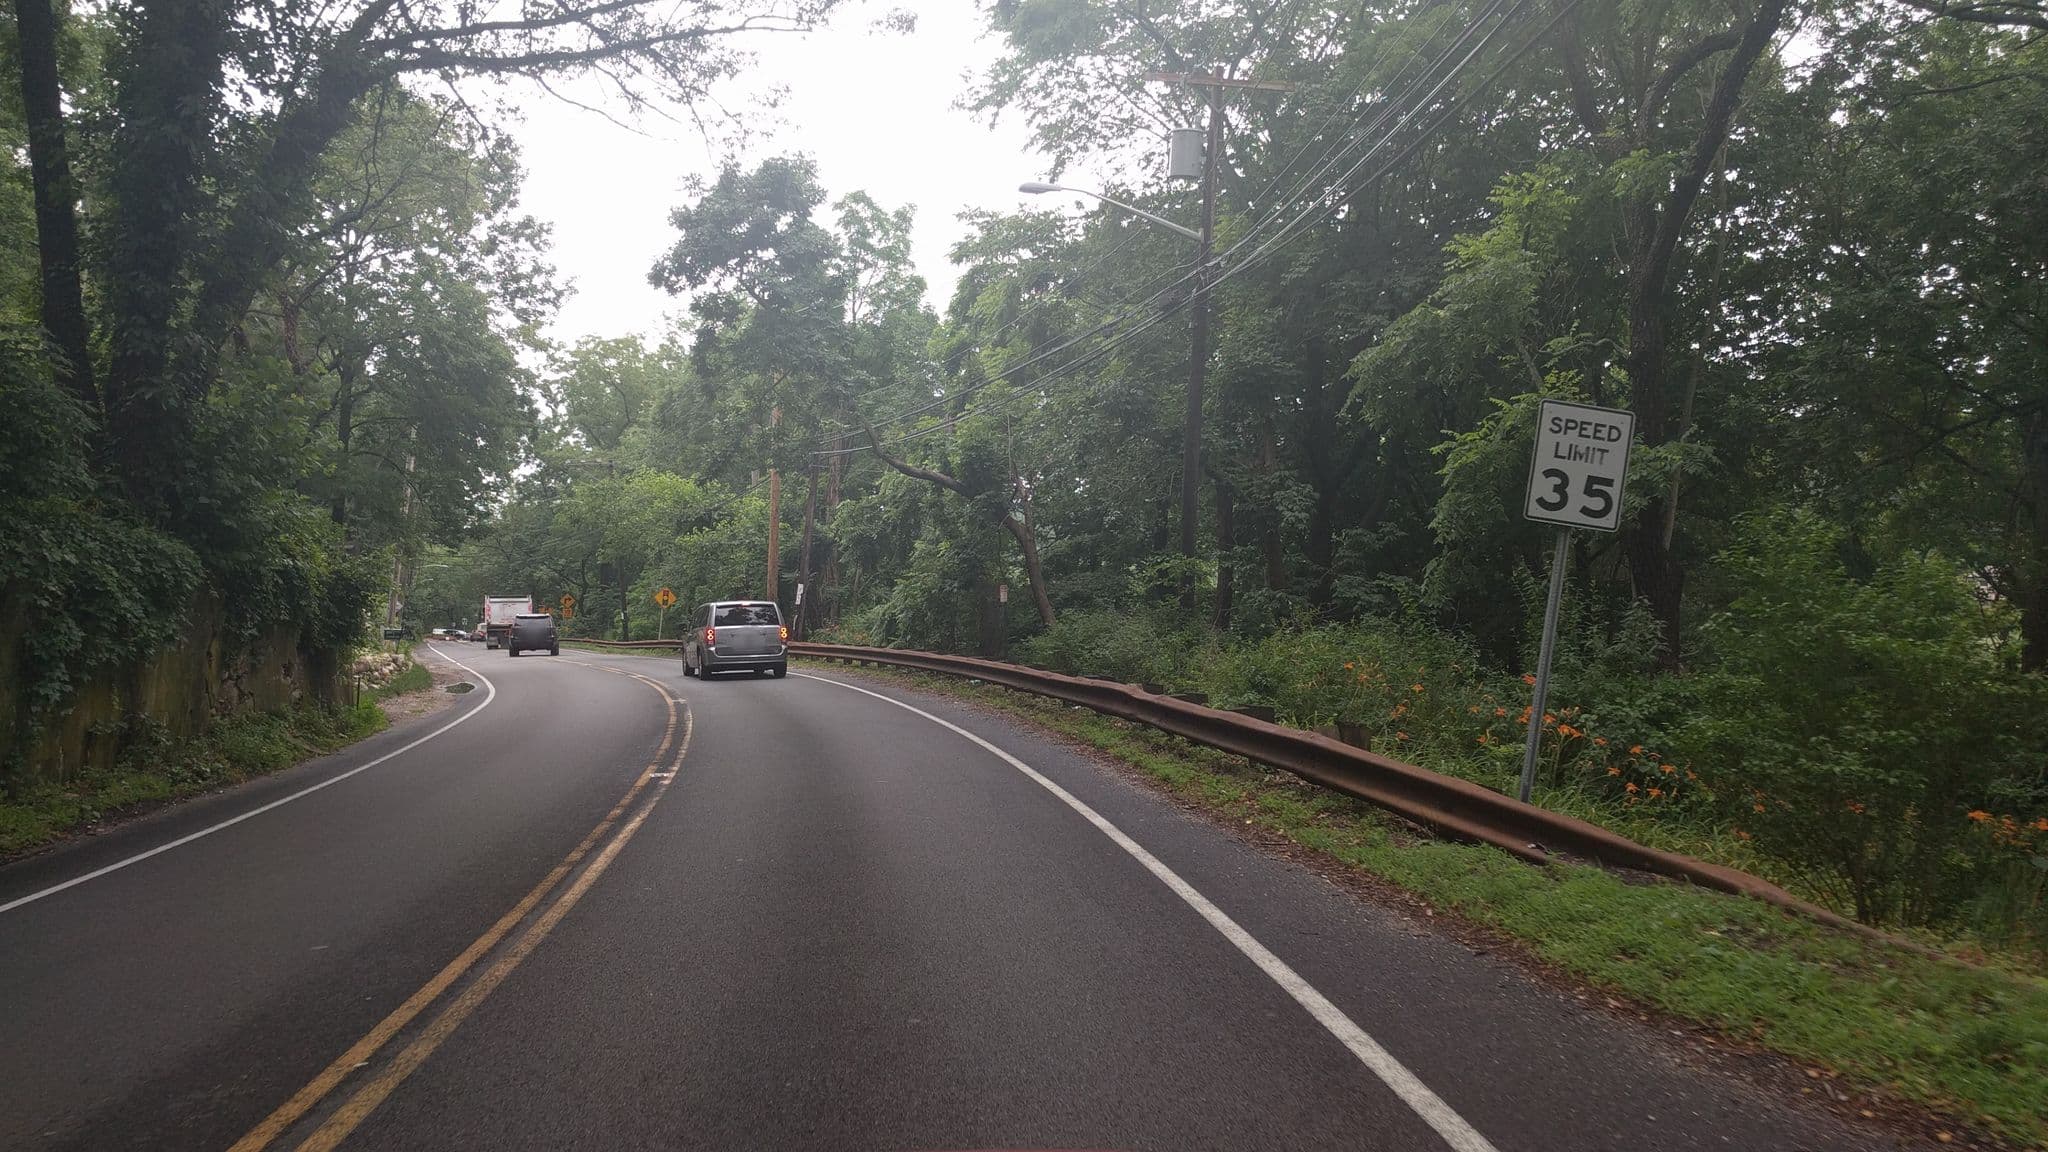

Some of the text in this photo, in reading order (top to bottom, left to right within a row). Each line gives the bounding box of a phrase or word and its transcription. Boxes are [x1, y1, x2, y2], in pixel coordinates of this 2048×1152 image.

[1548, 416, 1623, 443] SPEED
[1553, 441, 1610, 466] LIMIT
[1535, 468, 1615, 520] 35
